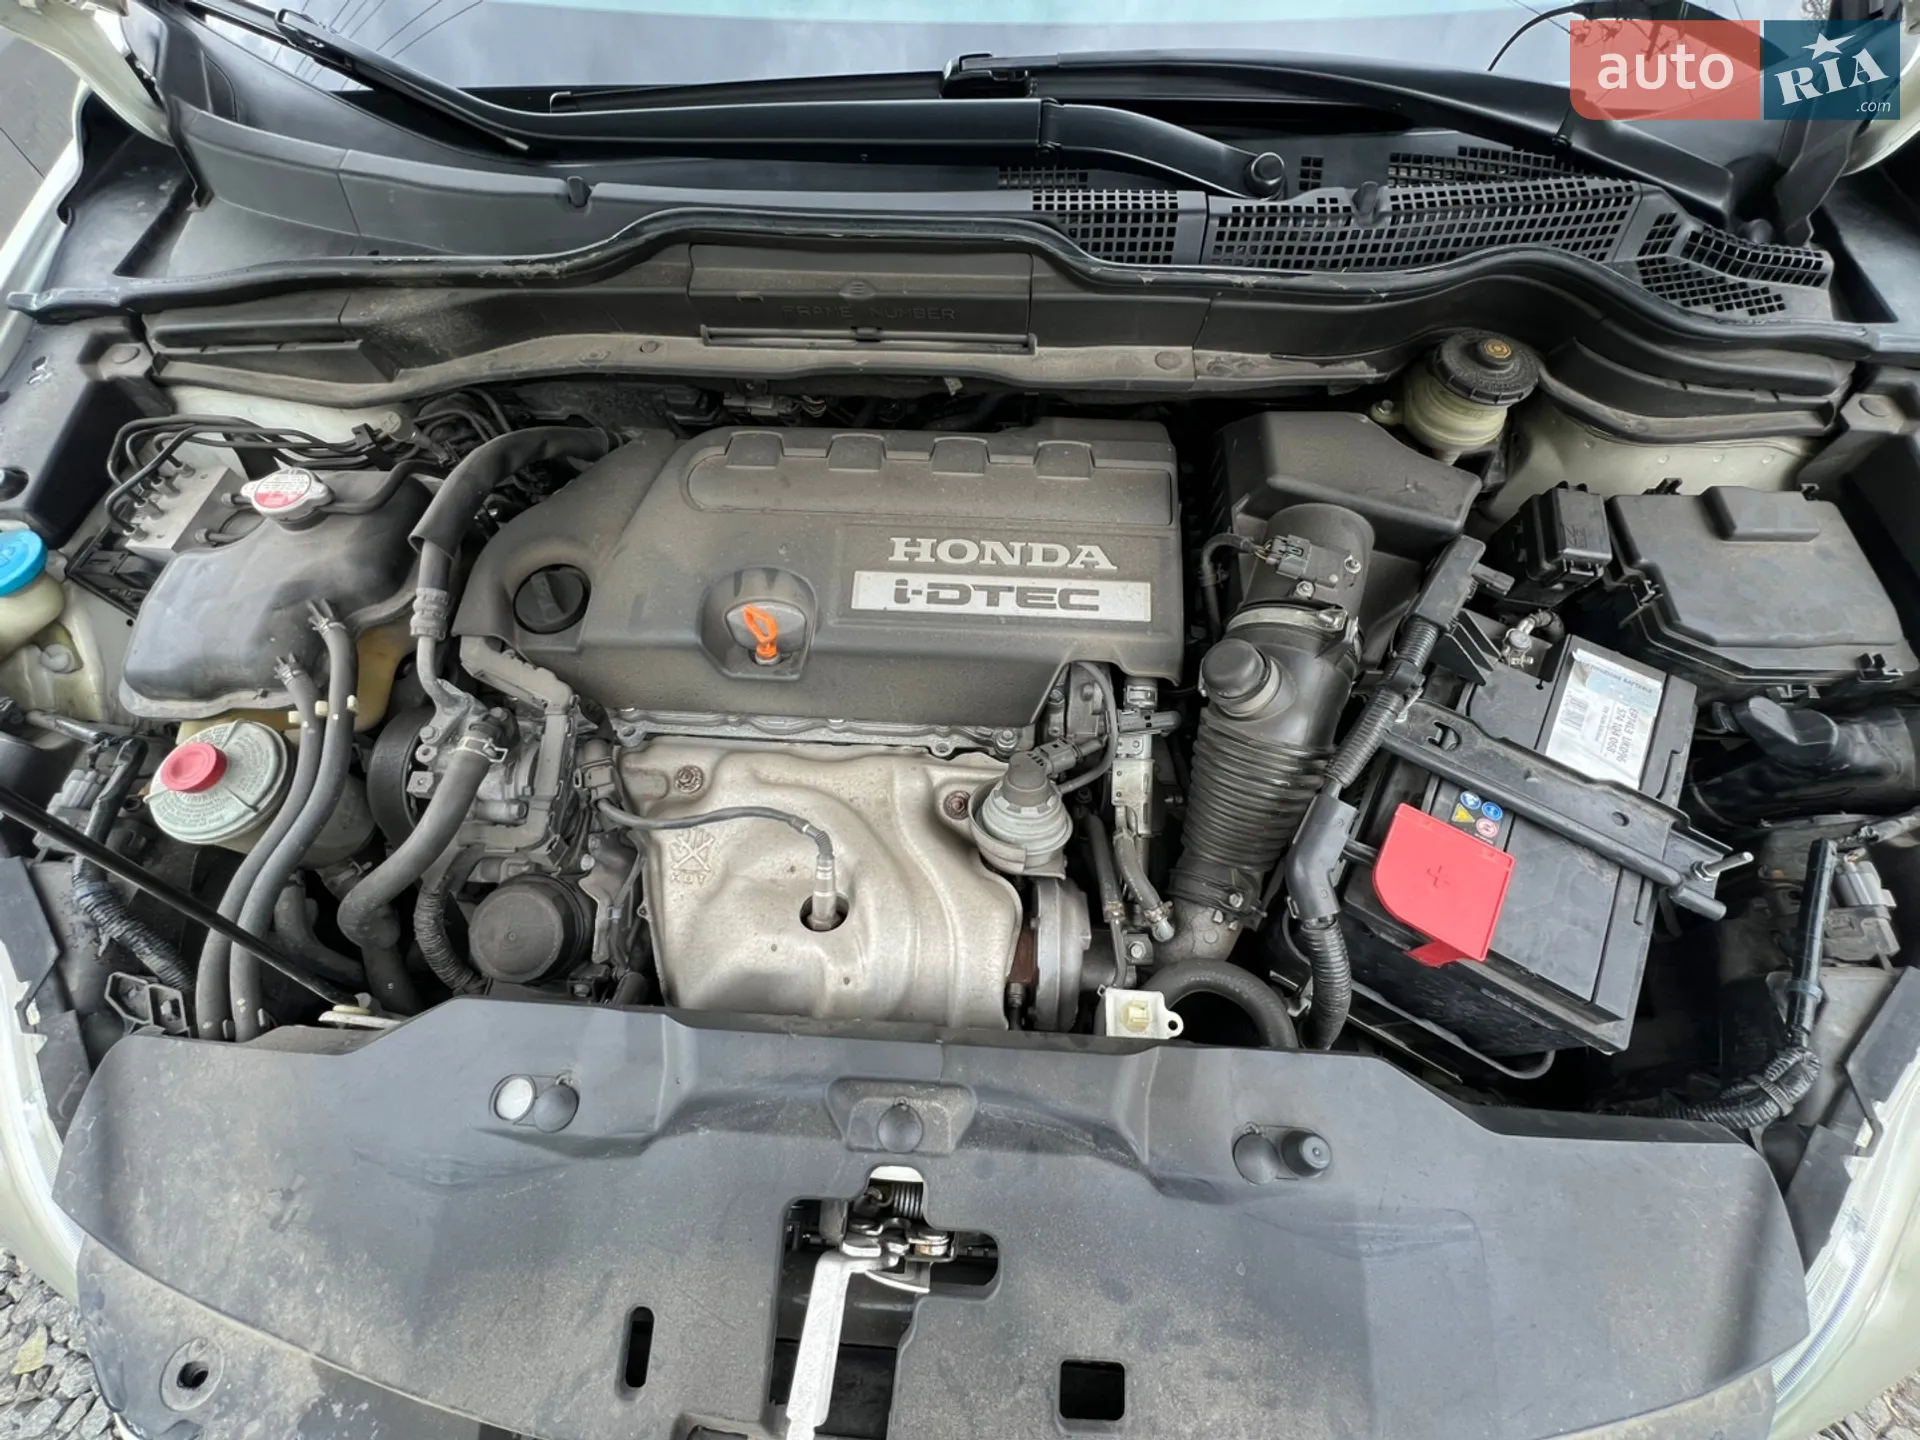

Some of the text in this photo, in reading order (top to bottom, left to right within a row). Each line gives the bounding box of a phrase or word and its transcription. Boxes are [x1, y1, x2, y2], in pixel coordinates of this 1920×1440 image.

[782, 305, 956, 320] FRAME NUMBER
[888, 537, 1118, 570] HONDA
[894, 578, 1100, 612] i-DTEC
